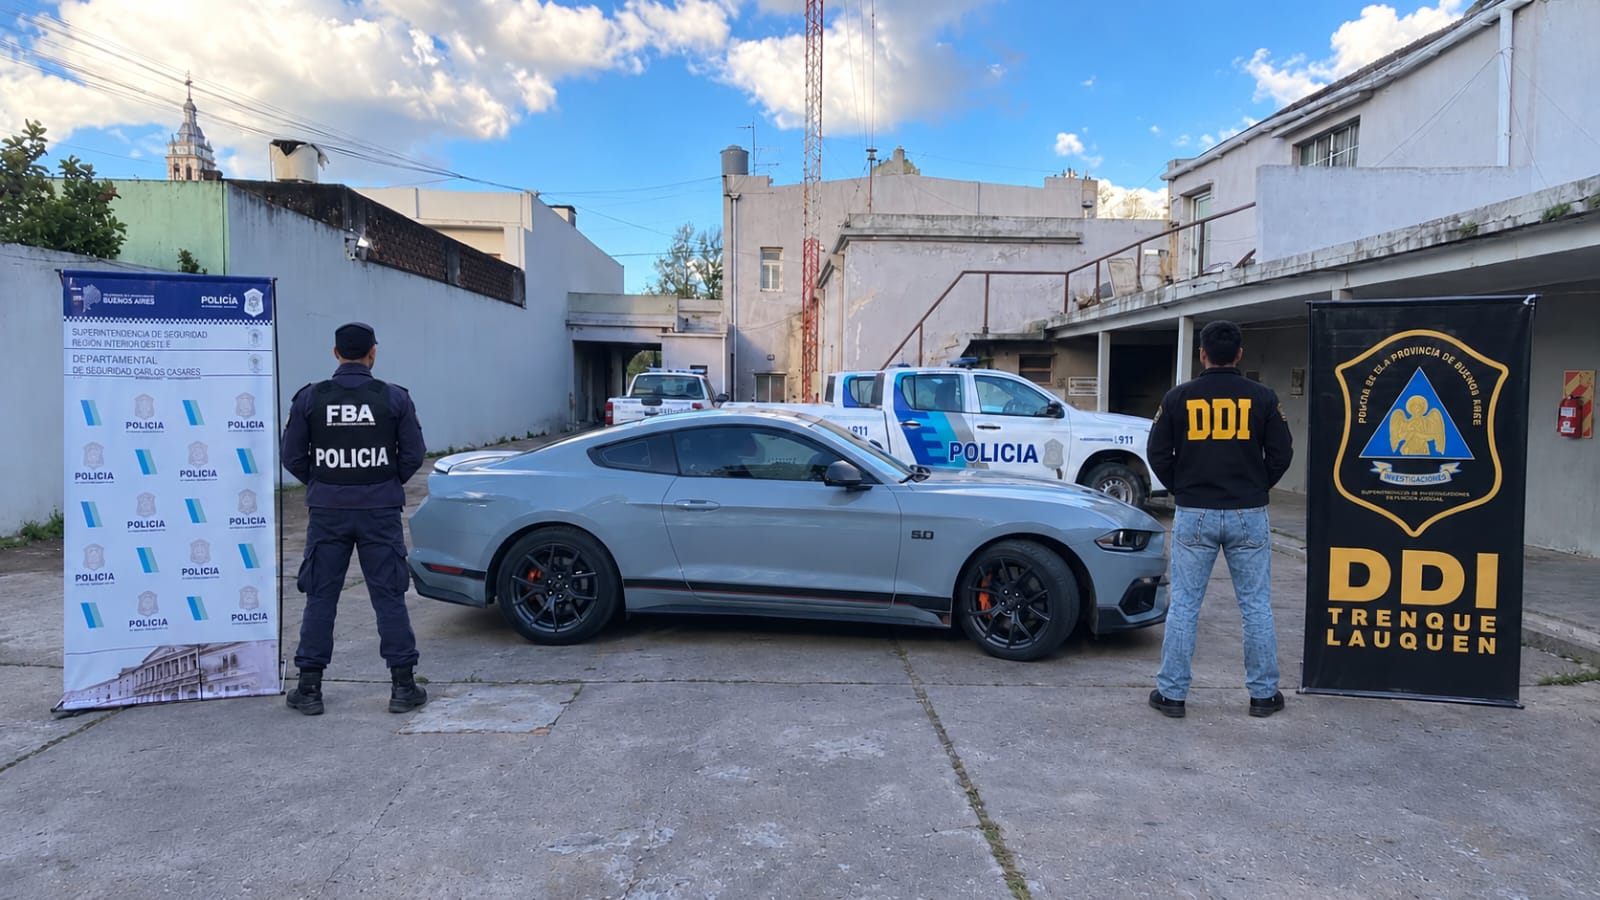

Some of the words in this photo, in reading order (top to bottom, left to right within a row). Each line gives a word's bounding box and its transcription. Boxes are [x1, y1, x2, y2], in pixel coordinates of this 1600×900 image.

[72, 328, 150, 338] SUPERINTENDENCIA
[151, 330, 161, 338] DE
[163, 330, 208, 339] SEGURIDAD
[104, 340, 140, 348] INTERIOR
[72, 354, 158, 365] DEPARTAMENTAL
[1390, 346, 1441, 362] PROVINCIA
[1441, 352, 1456, 364] DE
[72, 366, 84, 374] DE
[86, 367, 131, 375] SEGURIDAD
[133, 368, 165, 376] CARLOS
[166, 368, 200, 376] CASARES
[326, 404, 375, 423] FBA
[227, 420, 264, 429] POLICIA
[1186, 398, 1252, 441] DDI
[125, 421, 164, 430] POLICIA
[315, 446, 390, 469] POLICIA
[949, 441, 1039, 464] POLICIA
[74, 472, 114, 481] POLICIA
[179, 469, 217, 478] POLICIA
[127, 520, 165, 529] POLICIA
[229, 516, 266, 526] POLICIA
[182, 567, 220, 576] POLICIA
[75, 573, 115, 582] POLICIA
[1328, 547, 1499, 609] DDI
[231, 612, 268, 622] POLICIA
[1327, 608, 1497, 632] TRENQUE
[129, 618, 168, 628] POLICIA
[1326, 628, 1496, 655] LAUQUEN
